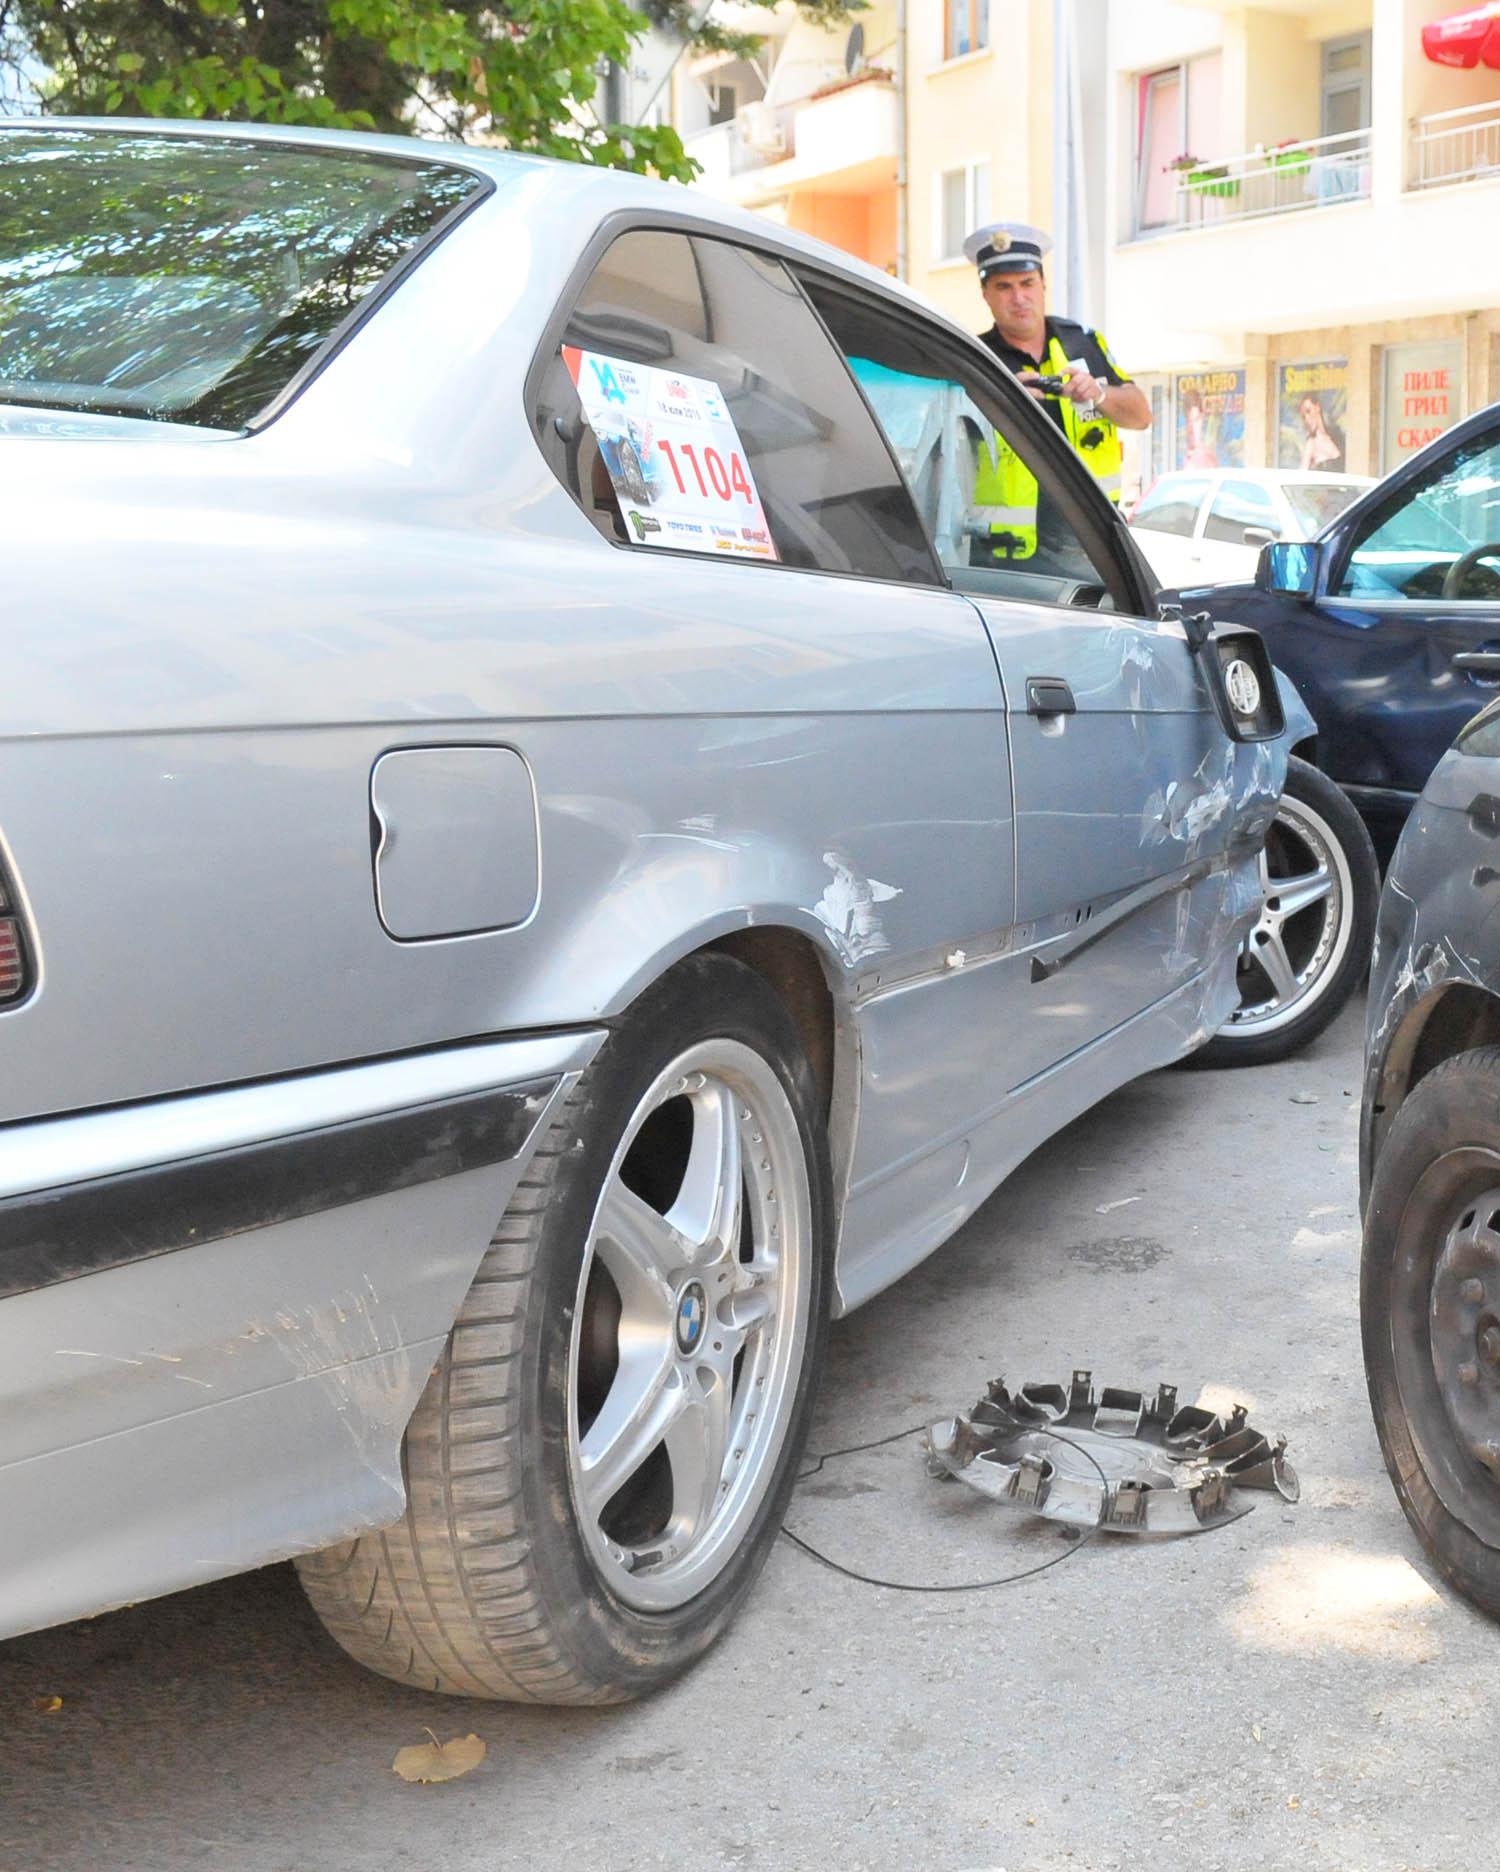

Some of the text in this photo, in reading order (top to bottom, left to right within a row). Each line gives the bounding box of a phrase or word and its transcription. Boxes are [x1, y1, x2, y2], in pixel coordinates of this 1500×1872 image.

[1404, 368, 1449, 392] ПИЛЕ
[1404, 395, 1448, 417] ГРИЛ
[657, 439, 753, 505] 1104
